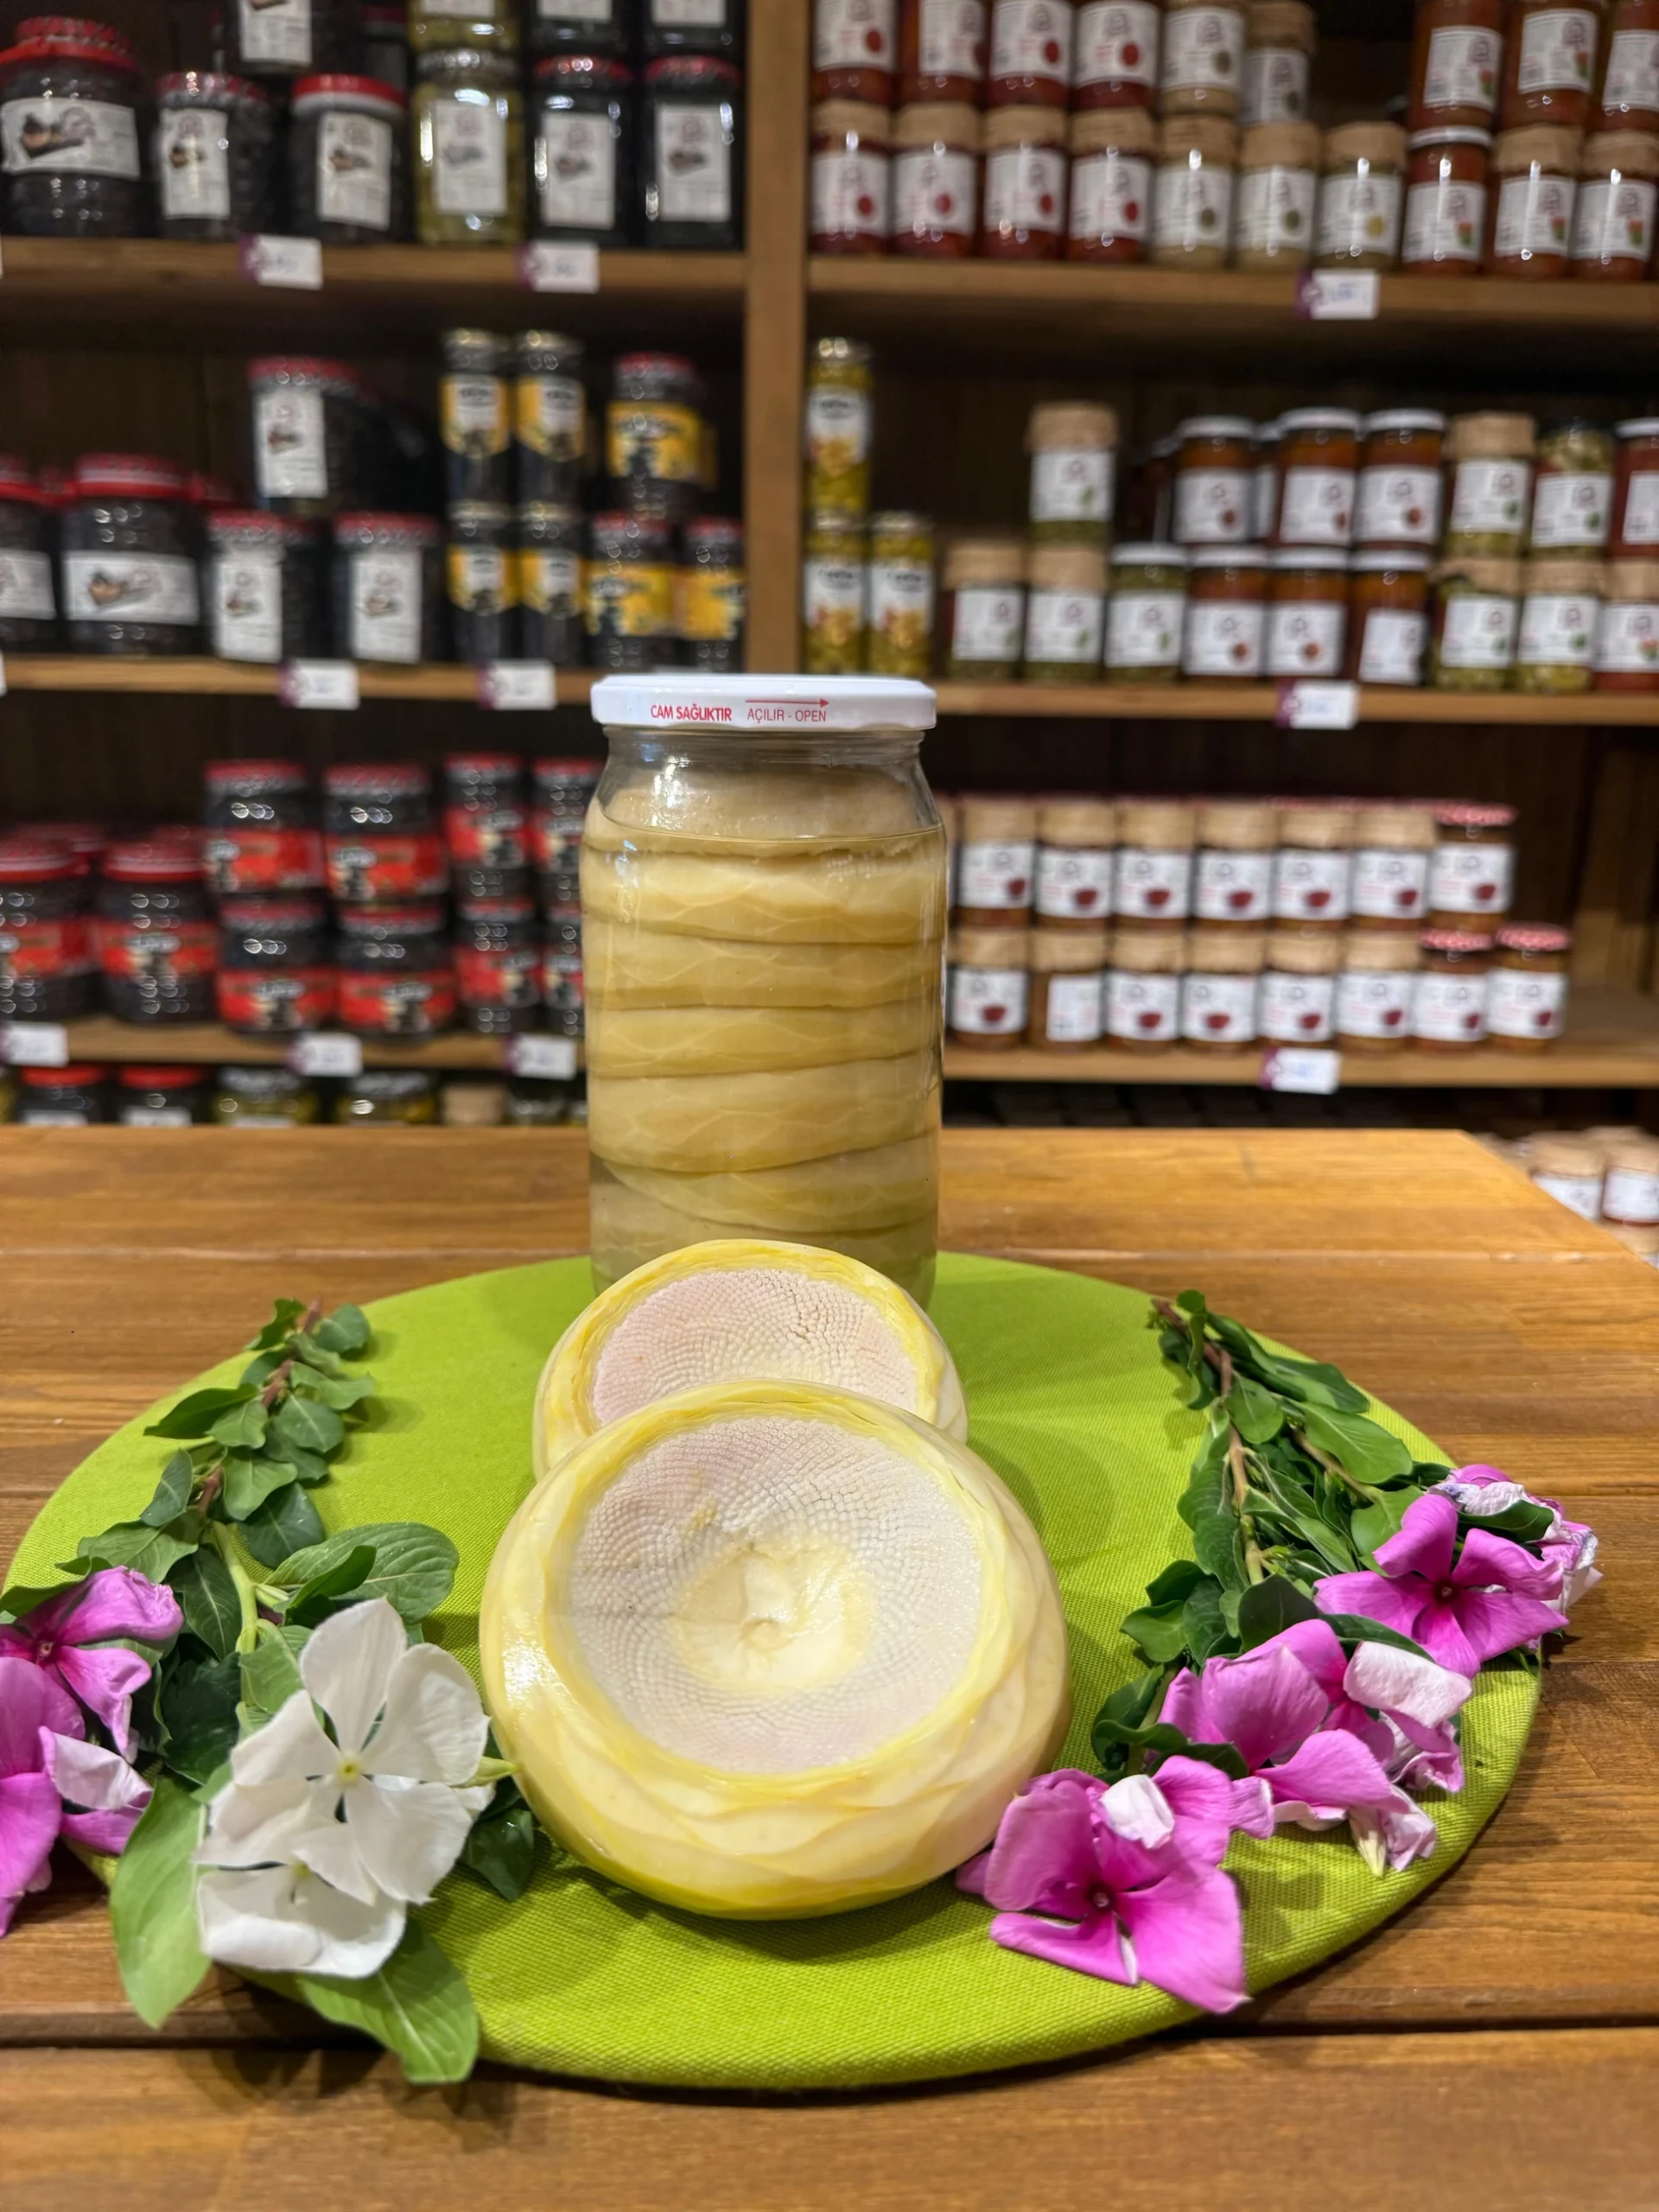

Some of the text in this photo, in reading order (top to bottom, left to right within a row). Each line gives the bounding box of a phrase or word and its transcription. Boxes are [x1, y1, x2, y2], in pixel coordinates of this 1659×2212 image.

[651, 703, 733, 721] CAM SAĞLIKTIR
[747, 709, 785, 724] AÇILIR
[795, 709, 827, 722] OPEN
